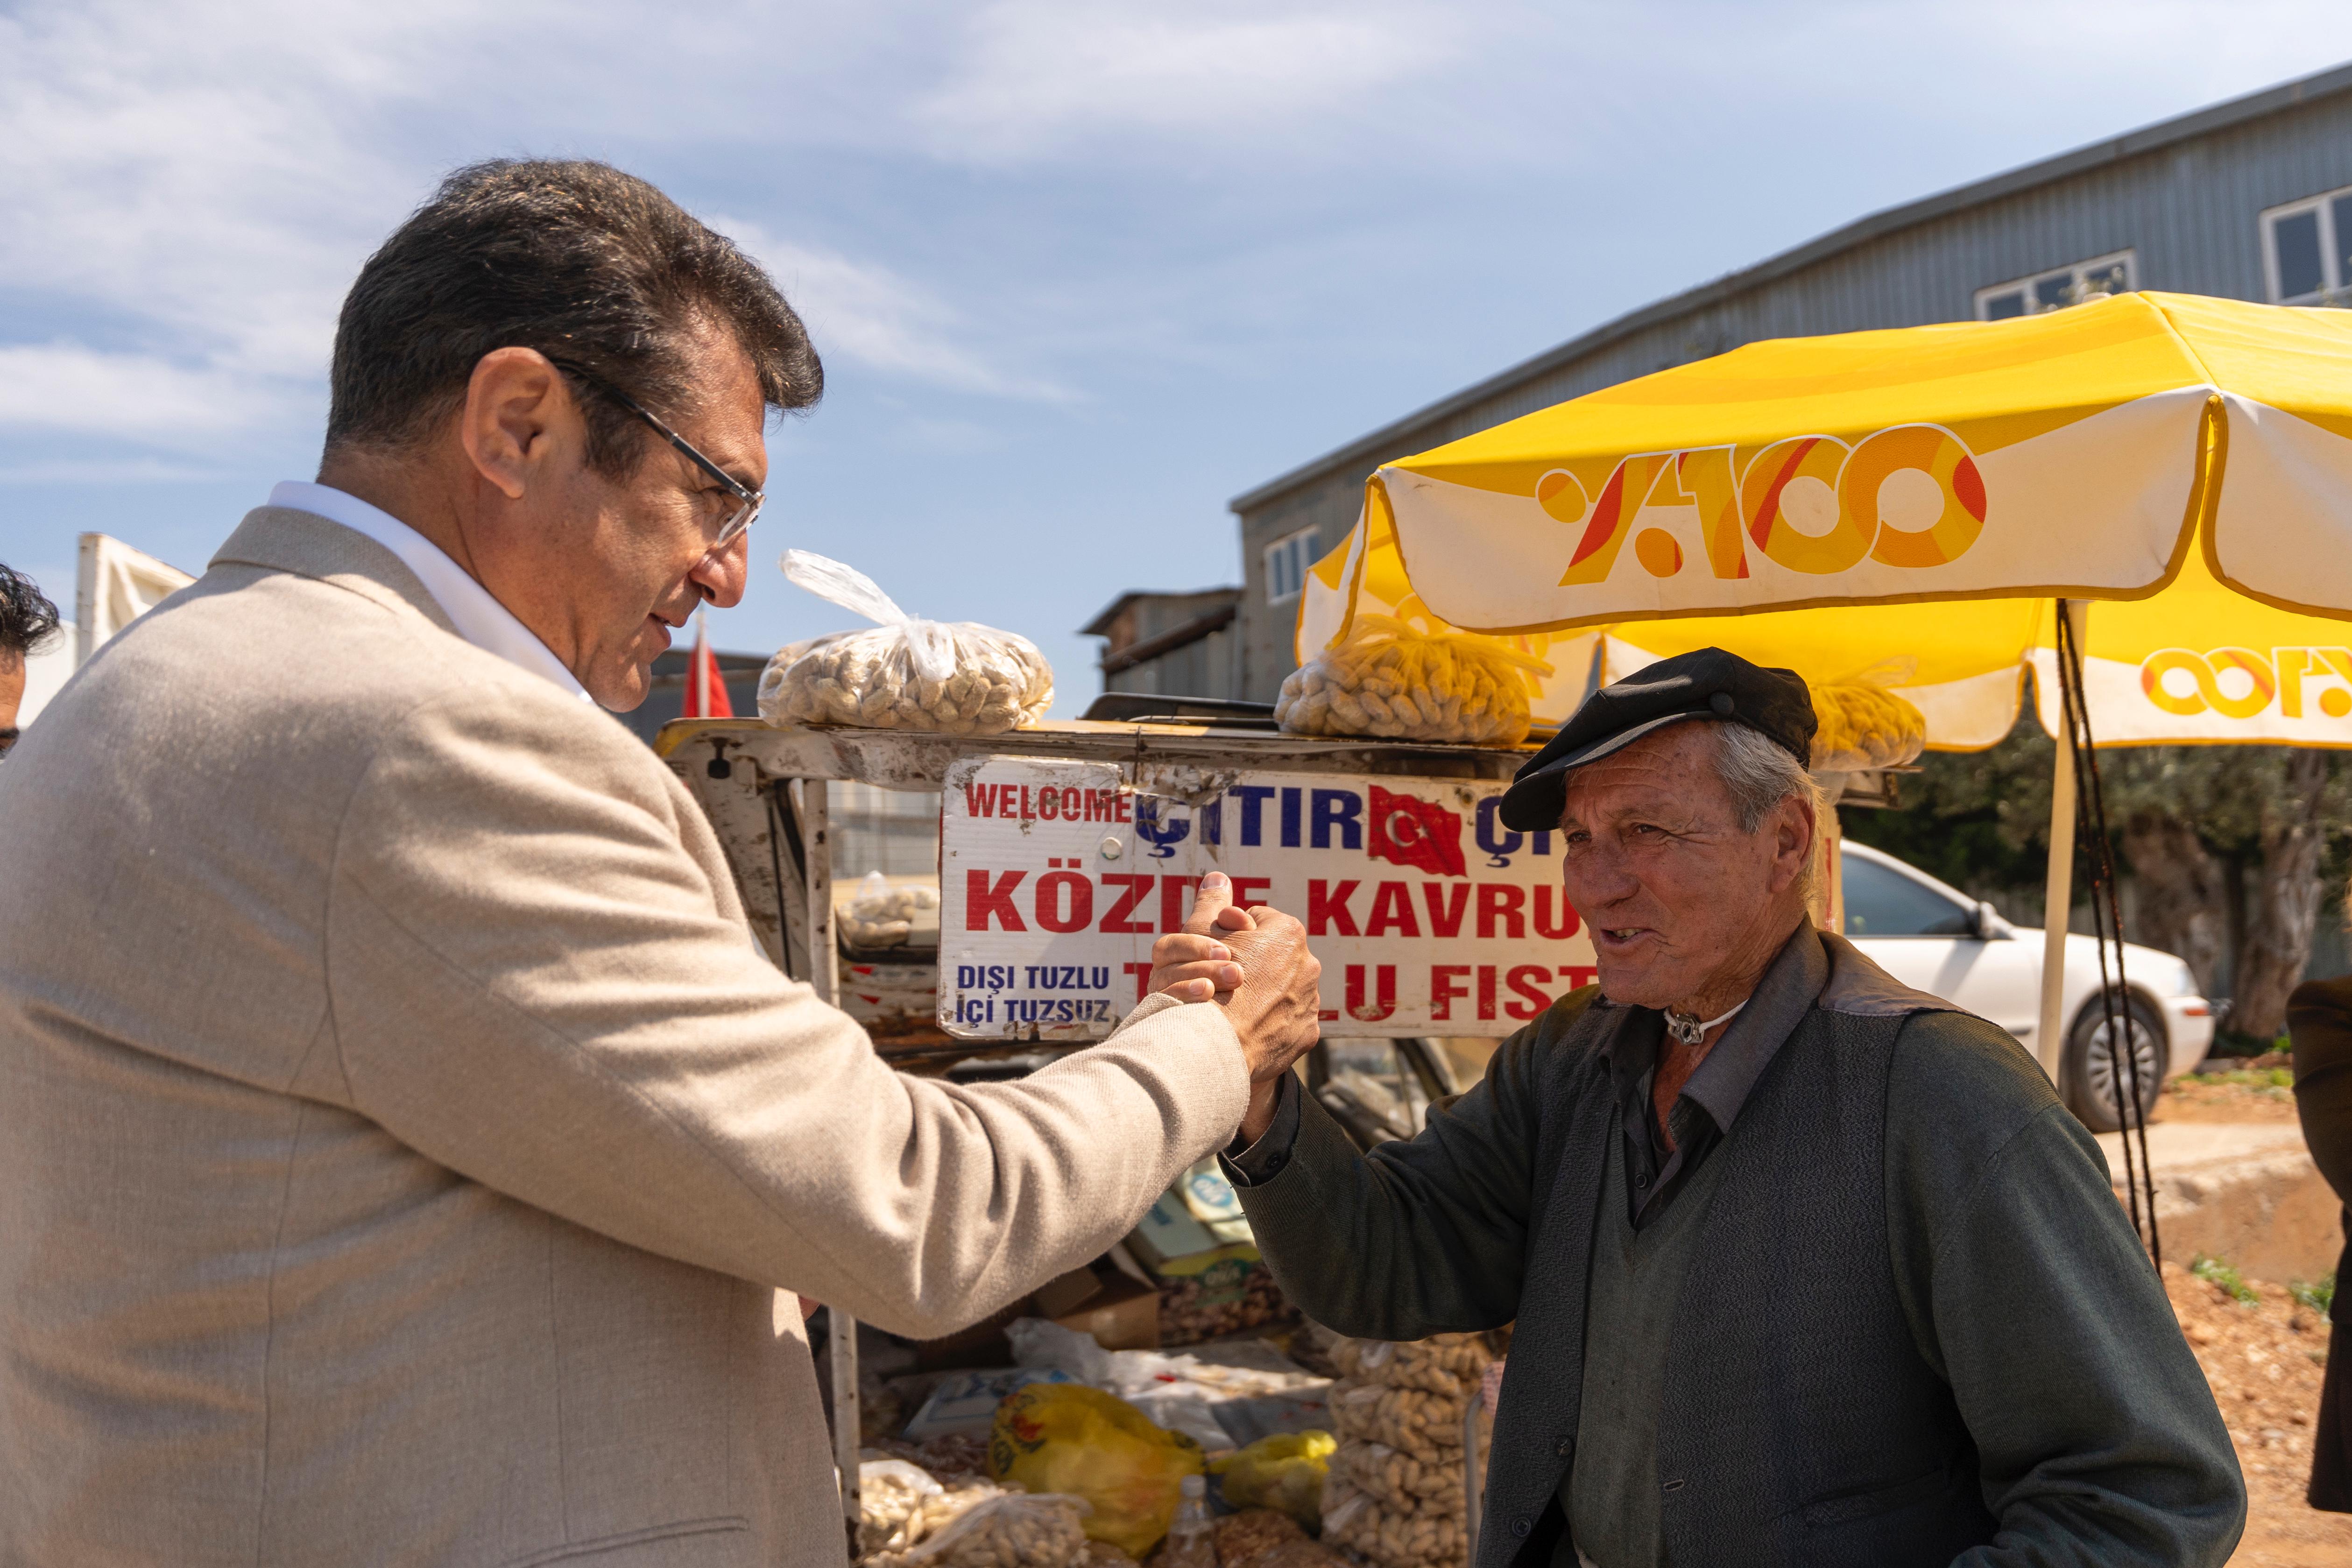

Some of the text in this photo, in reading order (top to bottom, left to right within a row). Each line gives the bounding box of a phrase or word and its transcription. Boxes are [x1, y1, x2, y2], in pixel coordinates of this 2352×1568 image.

[965, 782, 1132, 823] WELCOME
[1135, 785, 1363, 858] ÇITIR
[1308, 879, 1591, 939] KAVRU
[958, 965, 1109, 995] DIŞI TUZLU
[956, 994, 1110, 1028] İÇİ TUZSUZ
